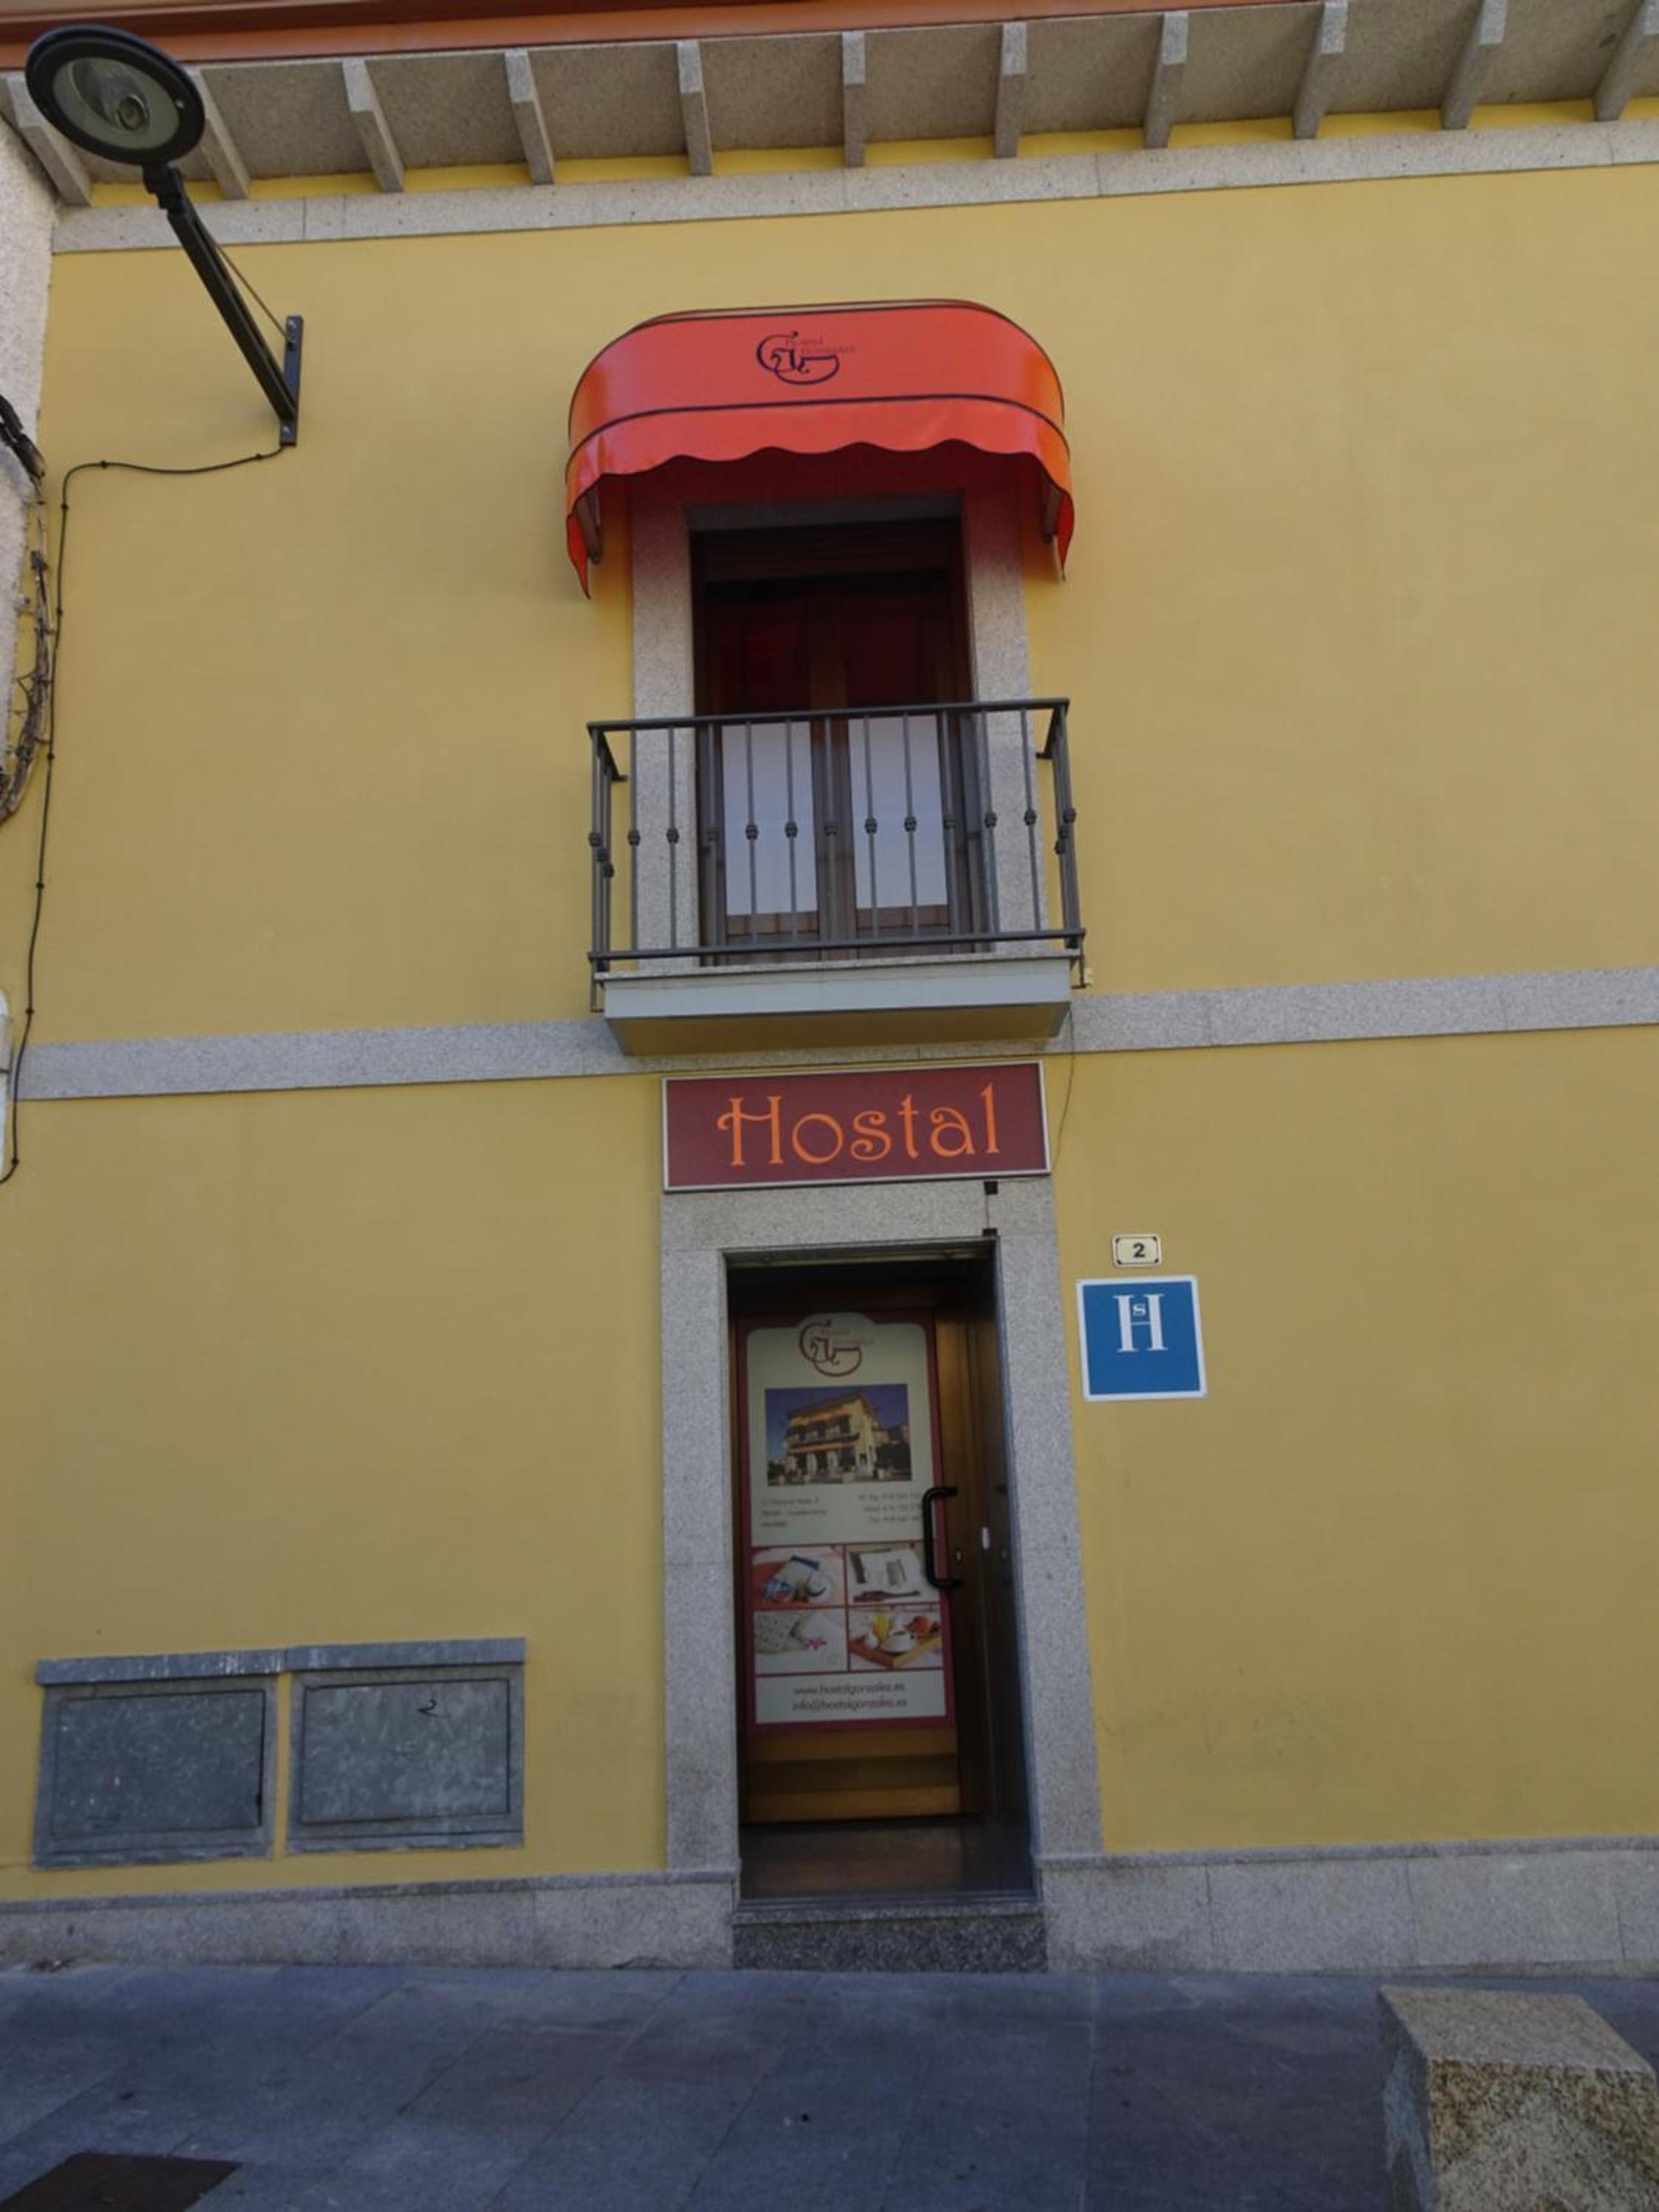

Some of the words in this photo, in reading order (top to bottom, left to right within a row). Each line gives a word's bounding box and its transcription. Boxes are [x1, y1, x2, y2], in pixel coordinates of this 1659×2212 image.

[717, 1083, 1000, 1166] Hostal
[1133, 1242, 1145, 1258] 2
[1113, 1293, 1168, 1352] H
